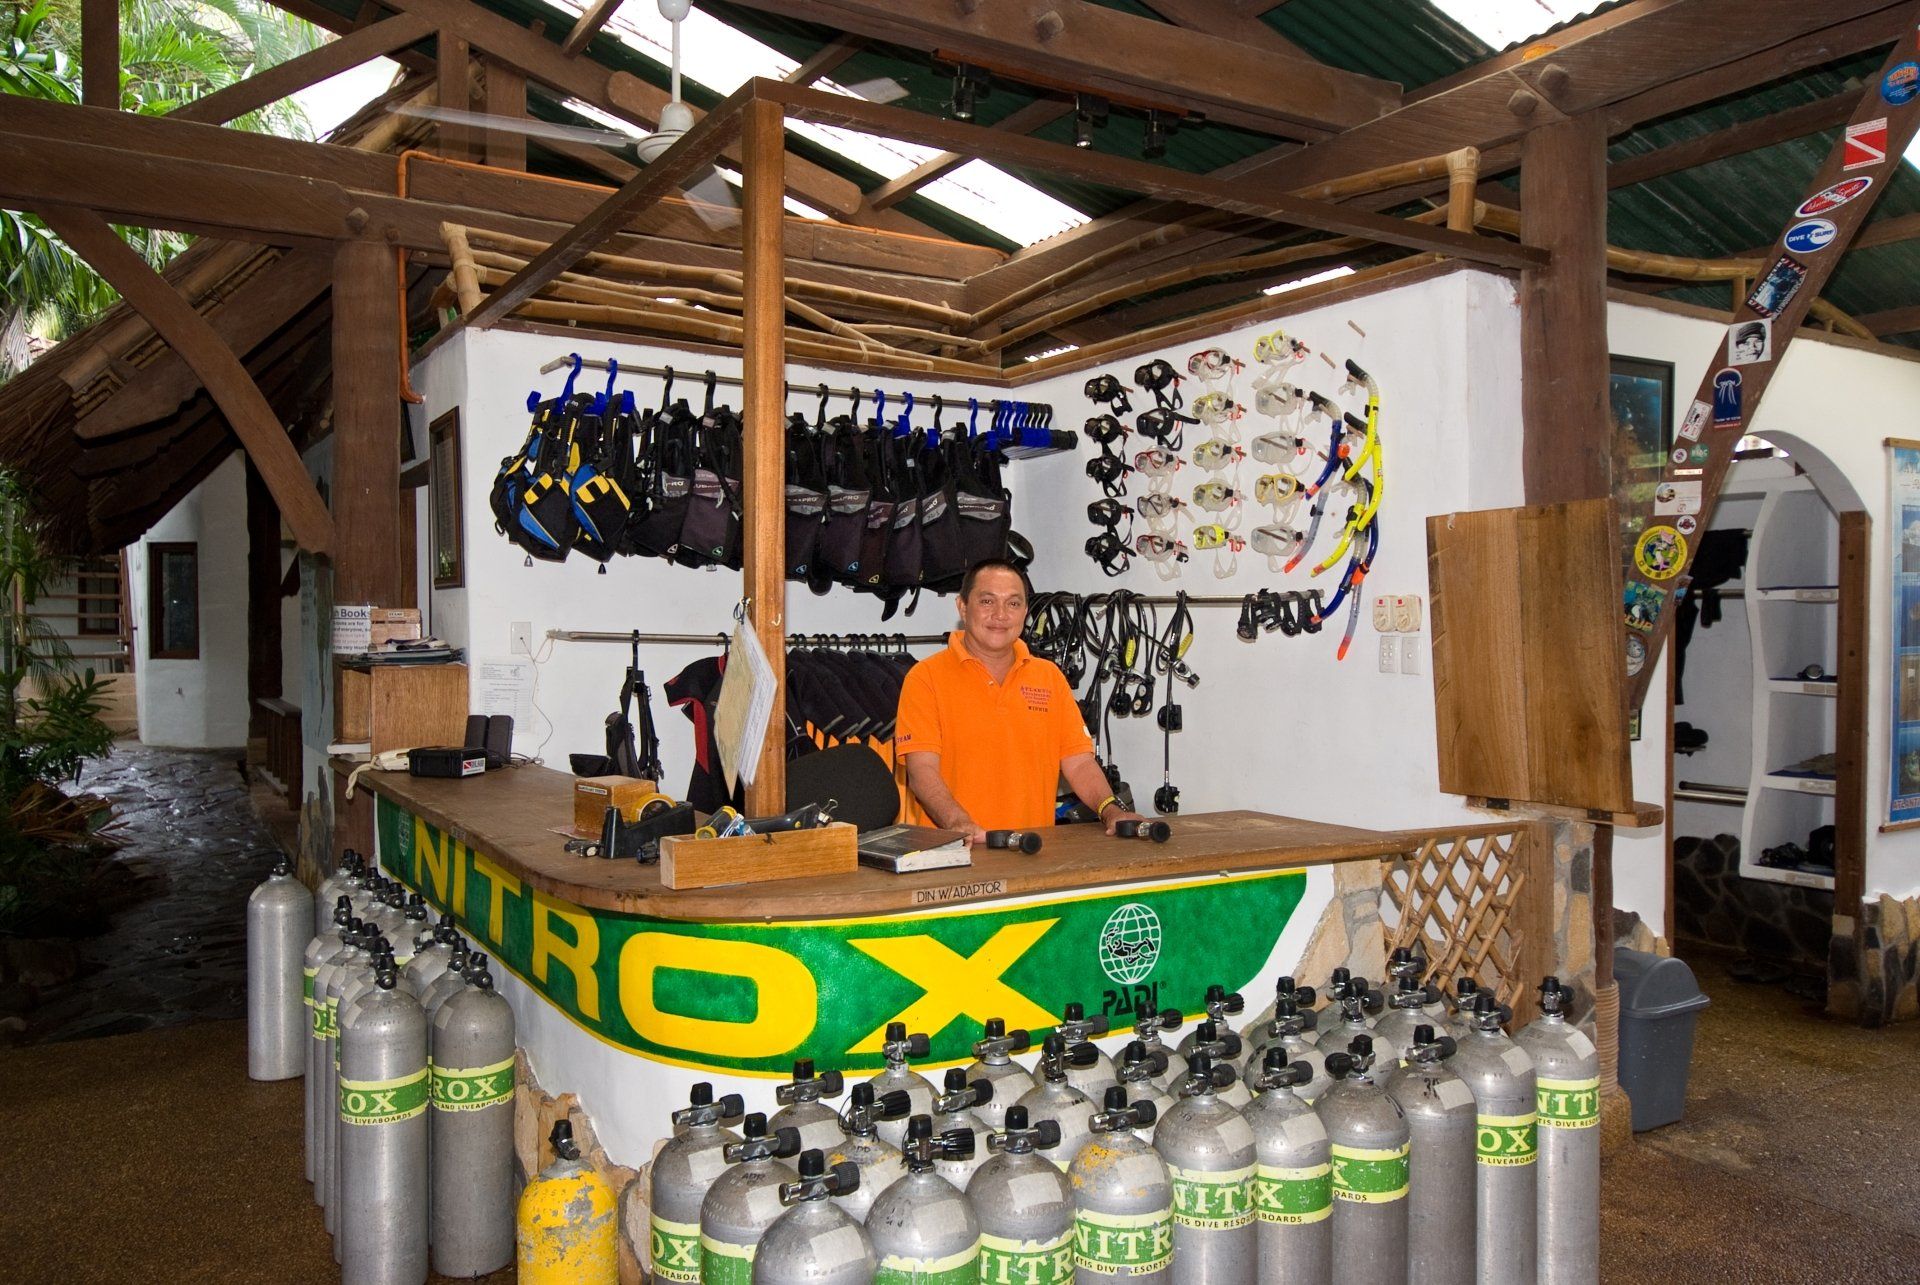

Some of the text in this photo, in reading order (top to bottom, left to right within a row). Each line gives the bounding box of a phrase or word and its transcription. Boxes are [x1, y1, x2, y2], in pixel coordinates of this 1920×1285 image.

[917, 889, 935, 903] DIN
[414, 814, 1064, 1058] NITROX
[1102, 981, 1158, 1016] PADI
[1194, 1220, 1219, 1228] DIVE
